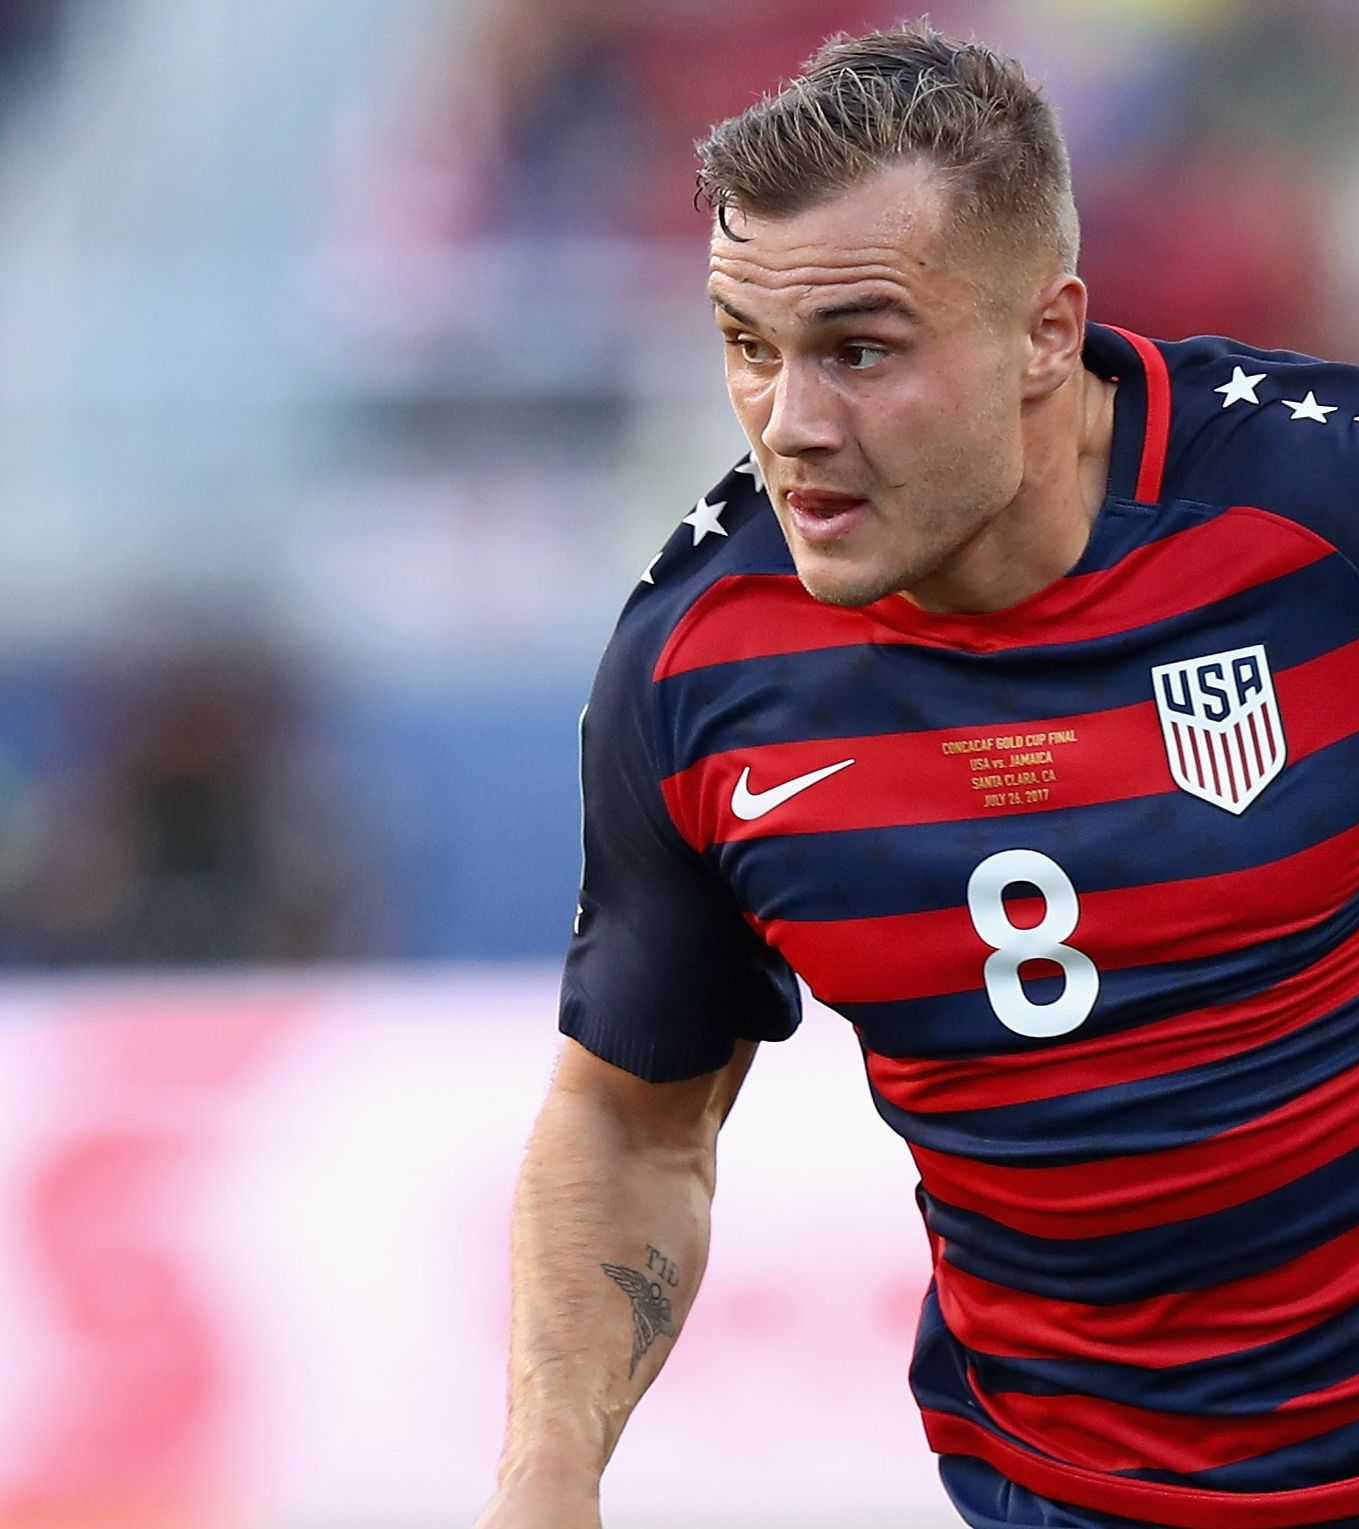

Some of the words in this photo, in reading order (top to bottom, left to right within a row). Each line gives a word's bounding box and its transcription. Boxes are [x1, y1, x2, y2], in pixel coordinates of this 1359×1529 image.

[1162, 655, 1263, 722] USA
[942, 738, 994, 755] CONCACAF
[996, 735, 1023, 749] GOLD
[1025, 733, 1046, 747] CUP
[1048, 730, 1078, 744] FINAL
[969, 758, 991, 771] USA
[1009, 751, 1054, 768] JAMAICA
[971, 775, 1003, 790] SANTA
[1042, 769, 1056, 783] CA
[984, 794, 1006, 808] JULY
[1025, 788, 1049, 803] 2017
[967, 849, 1100, 1038] 8
